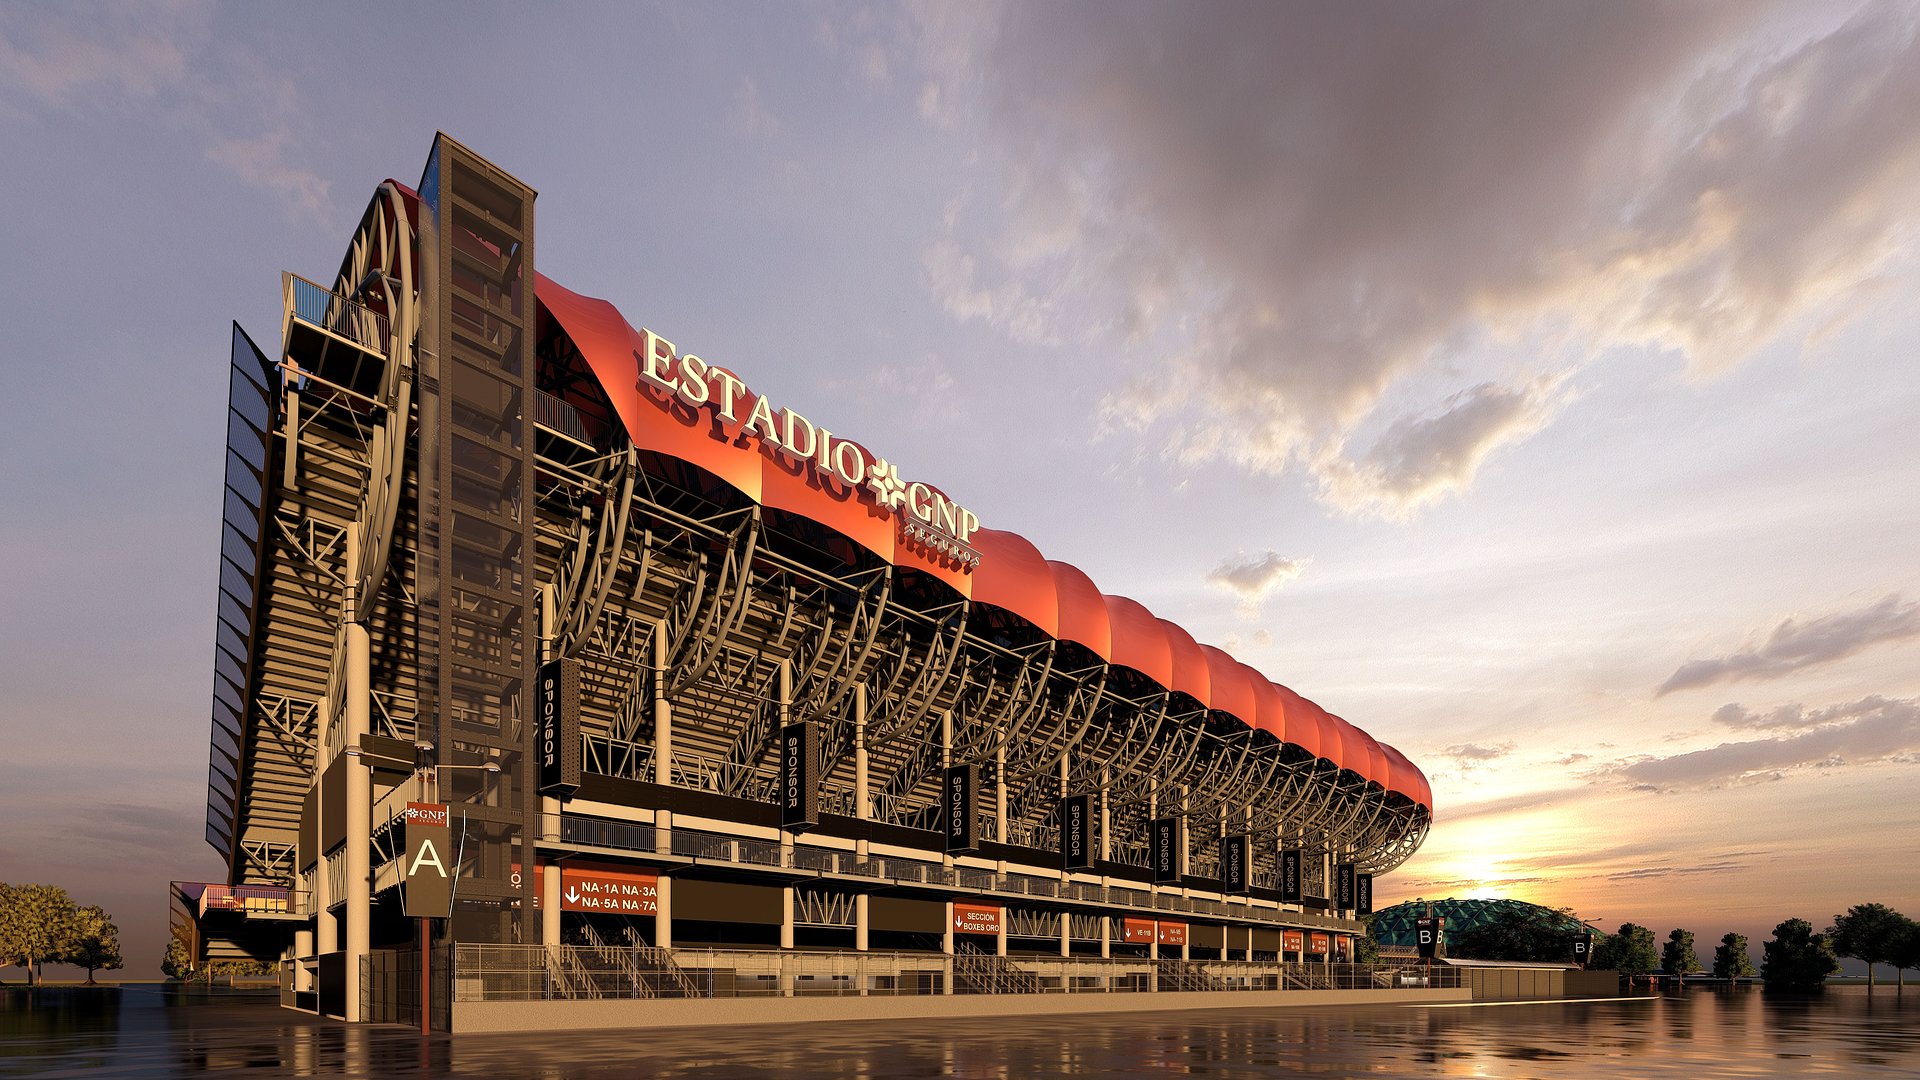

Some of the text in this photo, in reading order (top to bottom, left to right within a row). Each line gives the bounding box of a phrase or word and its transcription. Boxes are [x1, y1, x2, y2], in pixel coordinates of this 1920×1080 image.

[638, 327, 980, 544] ESTADIO GNP
[904, 522, 980, 568] SEGUROS
[544, 678, 554, 767] SPONSOR
[788, 737, 798, 809] SPONSOR
[419, 809, 445, 820] GNP
[952, 776, 962, 837] SPONSOR
[1071, 804, 1080, 857] SPONSOR
[1160, 826, 1169, 872] SPONSOR
[408, 839, 447, 878] A
[1230, 843, 1239, 884] SPONSOR
[963, 922, 1000, 932] BOXES ORO
[967, 911, 995, 922] SECCIÓN
[1420, 930, 1431, 944] B
[1437, 930, 1444, 944] B
[1575, 942, 1585, 953] B
